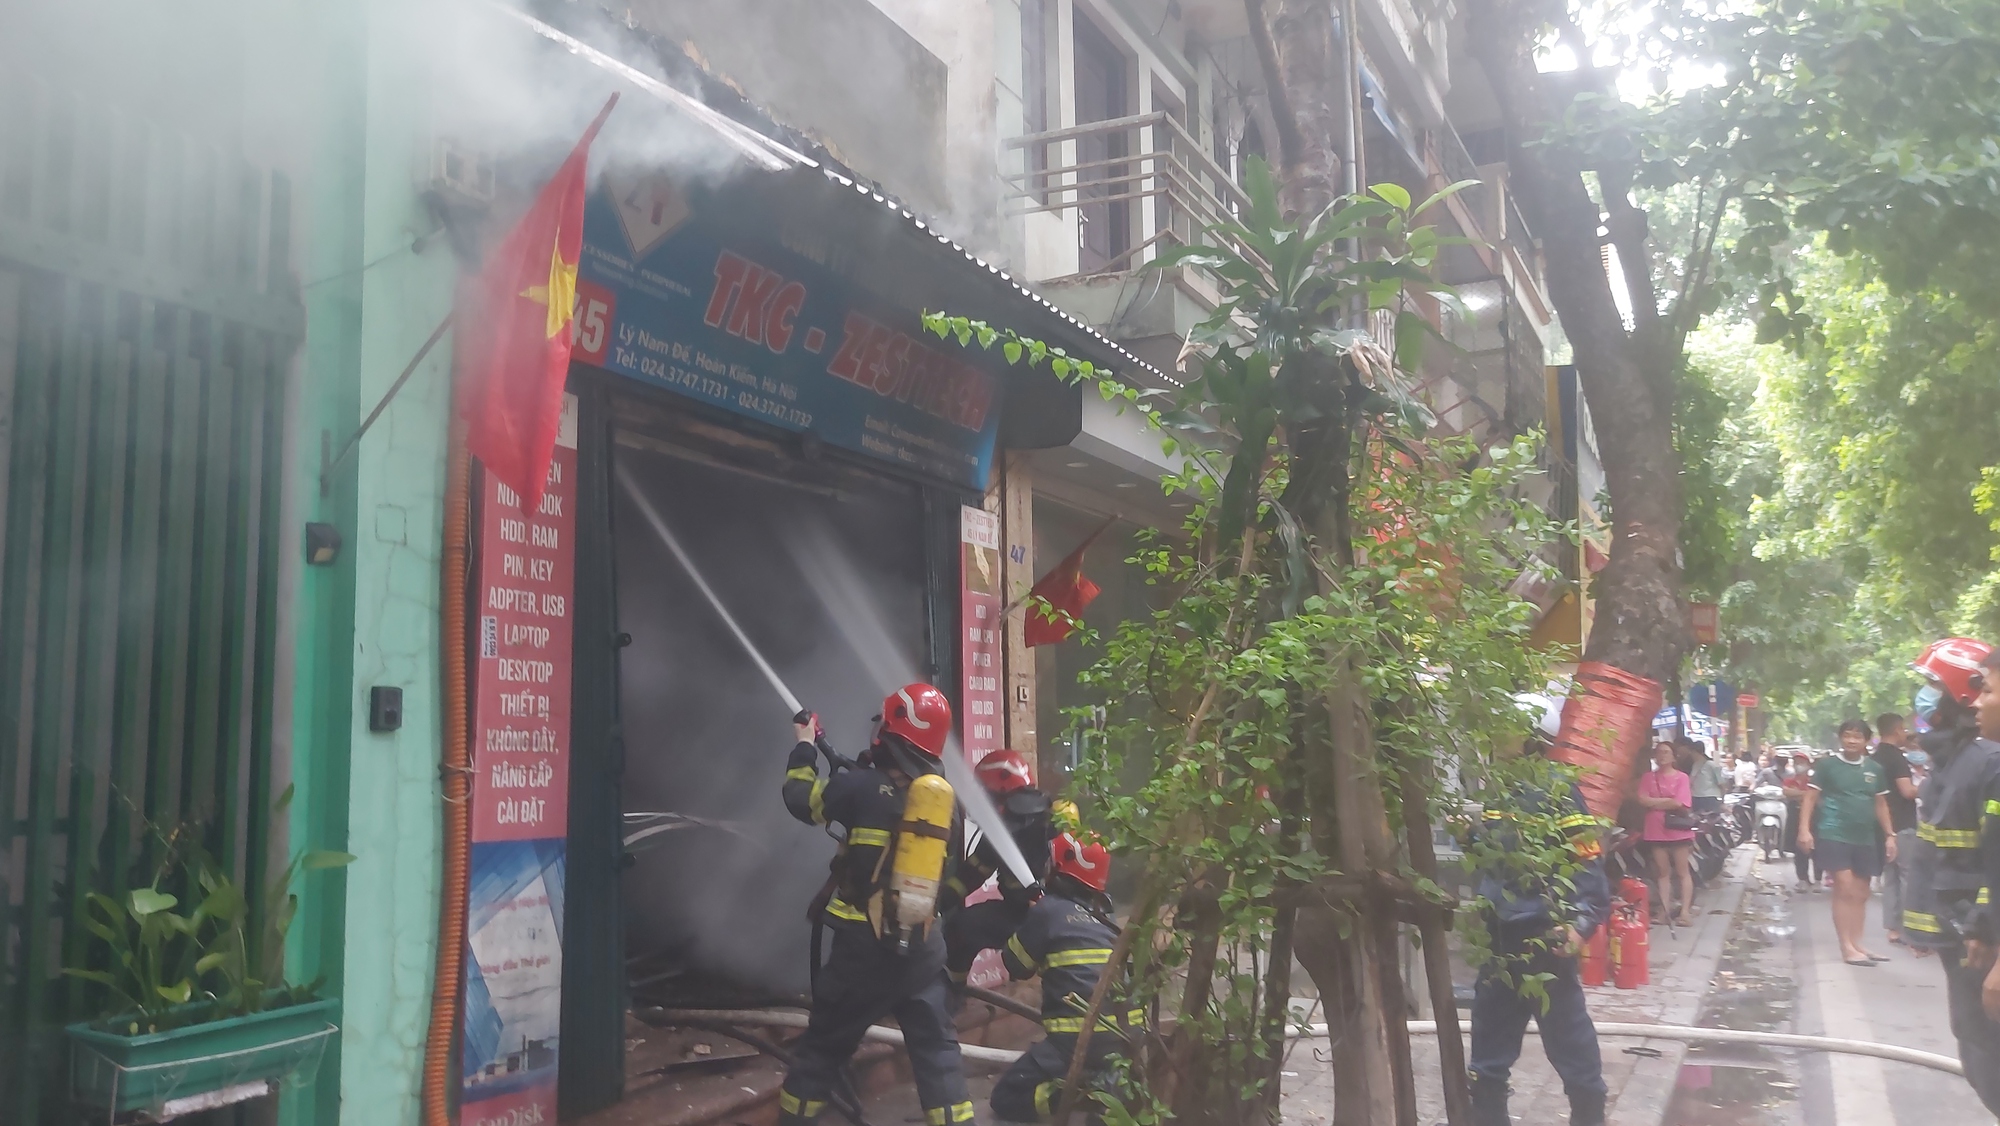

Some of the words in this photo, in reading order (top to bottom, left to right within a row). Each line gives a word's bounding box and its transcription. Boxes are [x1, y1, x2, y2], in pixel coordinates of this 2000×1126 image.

[704, 248, 807, 354] TKC
[619, 322, 634, 346] Lý
[638, 329, 669, 355] Nam
[615, 346, 637, 369] Tel:
[641, 356, 728, 400] 024.3747.1731
[500, 517, 529, 547] HDD,
[532, 524, 558, 550] RAM
[504, 553, 527, 580] PIN,
[530, 558, 554, 582] KEY
[488, 586, 540, 617] ADPTER,
[542, 594, 565, 617] USB
[504, 623, 550, 648] LAPTOP
[498, 658, 553, 683] DESKTOP
[500, 688, 535, 718] THIẾT
[537, 695, 550, 722] BỊ
[486, 724, 530, 753] KHÔNG
[532, 726, 559, 754] DÂY,
[492, 761, 527, 788] NÂNG
[529, 758, 553, 788] CẤP
[497, 796, 518, 824] CÀI
[521, 796, 546, 827] ĐẶT
